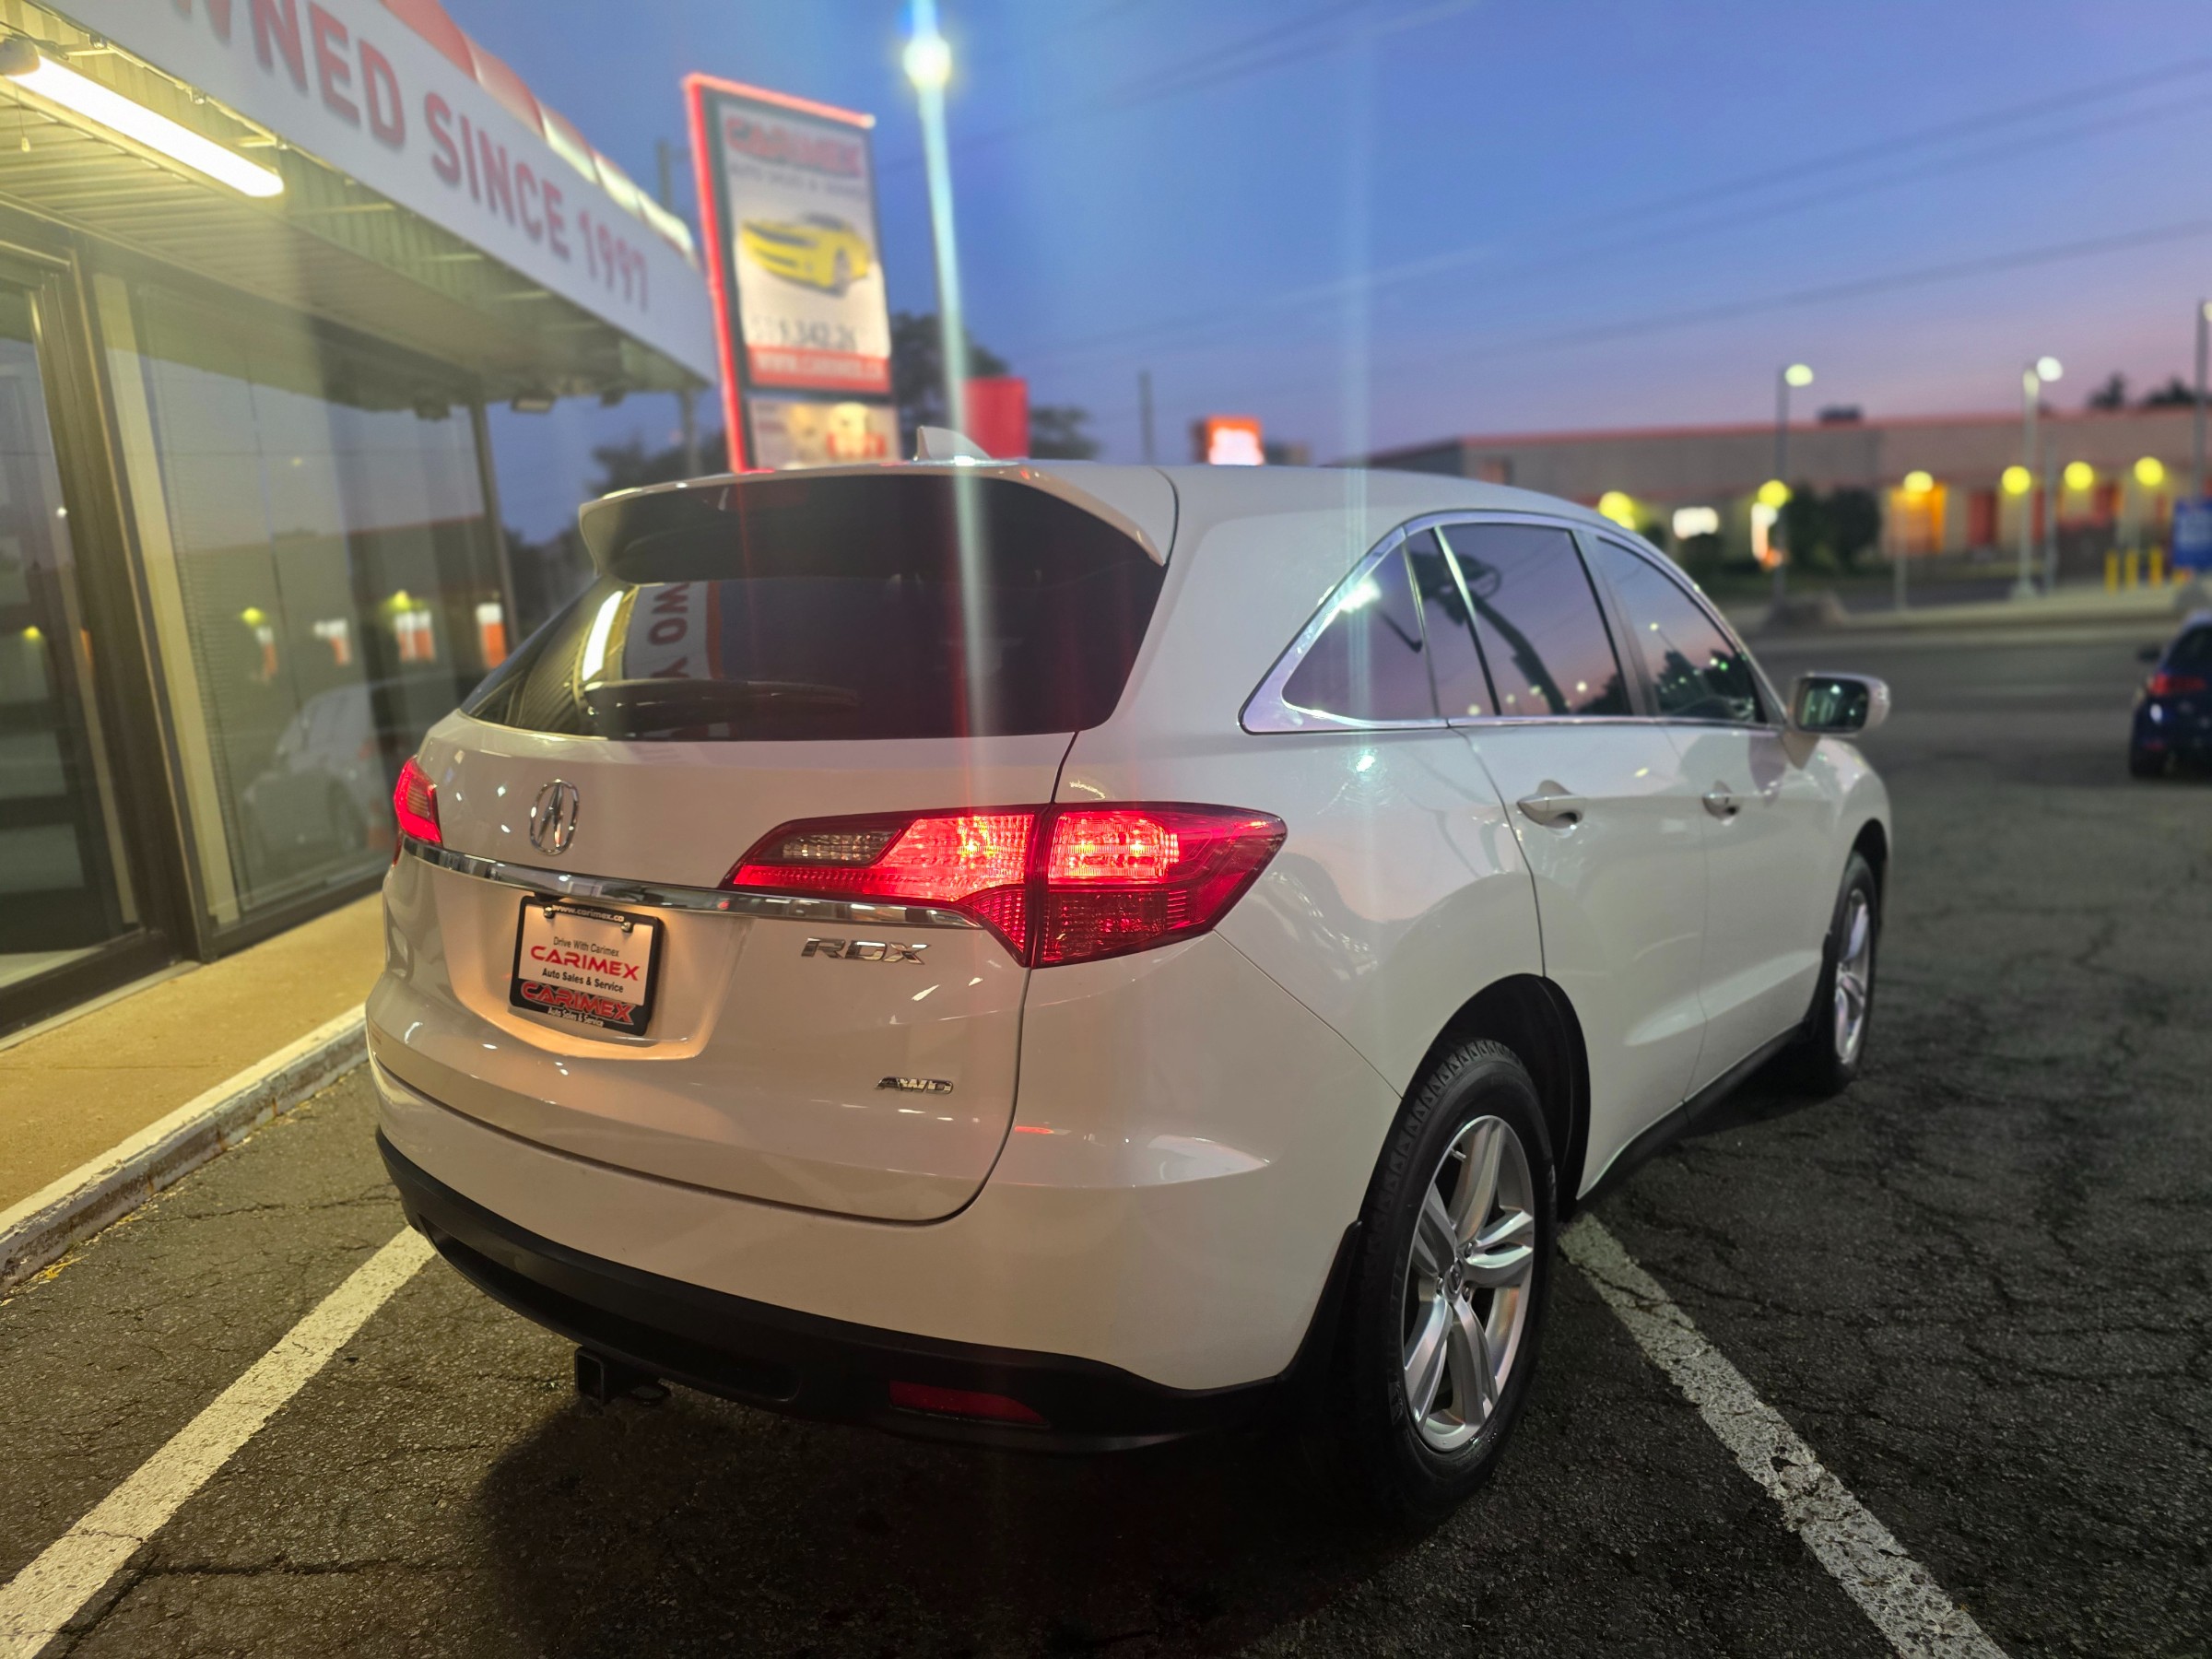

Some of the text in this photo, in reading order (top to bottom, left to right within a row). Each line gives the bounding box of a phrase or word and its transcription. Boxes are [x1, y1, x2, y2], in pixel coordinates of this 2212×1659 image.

[424, 90, 571, 263] SINCE
[577, 209, 650, 313] 1997
[553, 936, 619, 958] Drive With Carimex
[801, 936, 931, 965] RDX
[530, 946, 640, 981] CARIMEX
[542, 968, 624, 994] Auto Sales & Service
[521, 981, 635, 1025] CARIMEX
[876, 1077, 954, 1095] AWD
